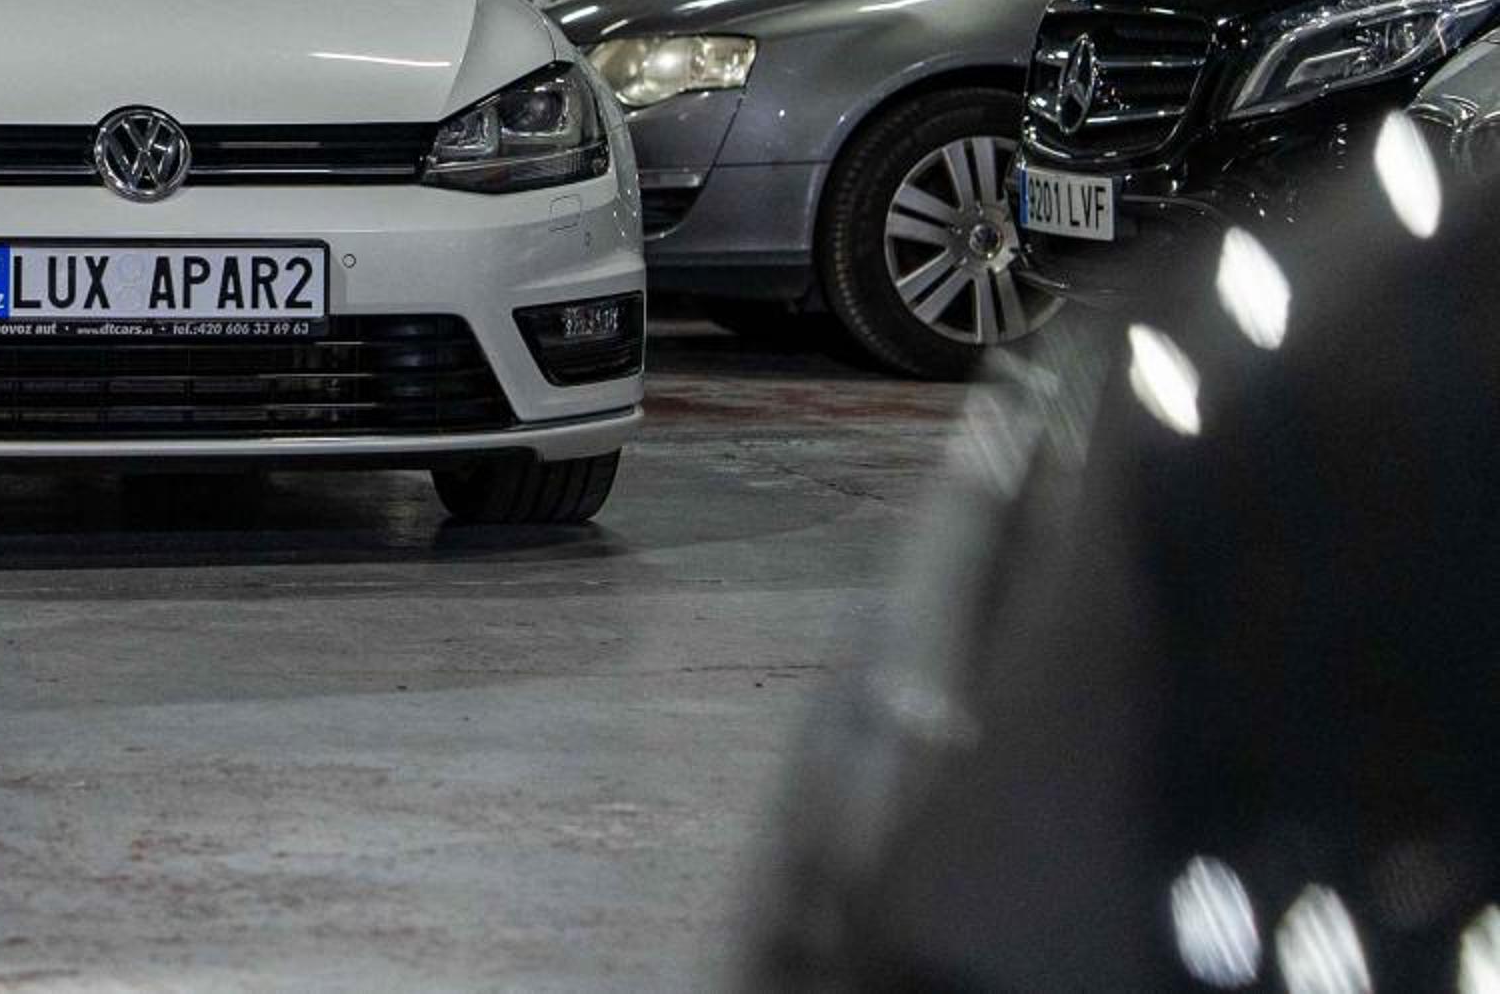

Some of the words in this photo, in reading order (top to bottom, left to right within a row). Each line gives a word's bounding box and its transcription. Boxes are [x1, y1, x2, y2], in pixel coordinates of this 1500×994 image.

[1068, 182, 1106, 229] LVF
[12, 255, 110, 309] LUX
[148, 255, 313, 309] APAR2
[35, 322, 57, 335] aut
[226, 322, 249, 335] 606
[293, 322, 309, 335] 63
